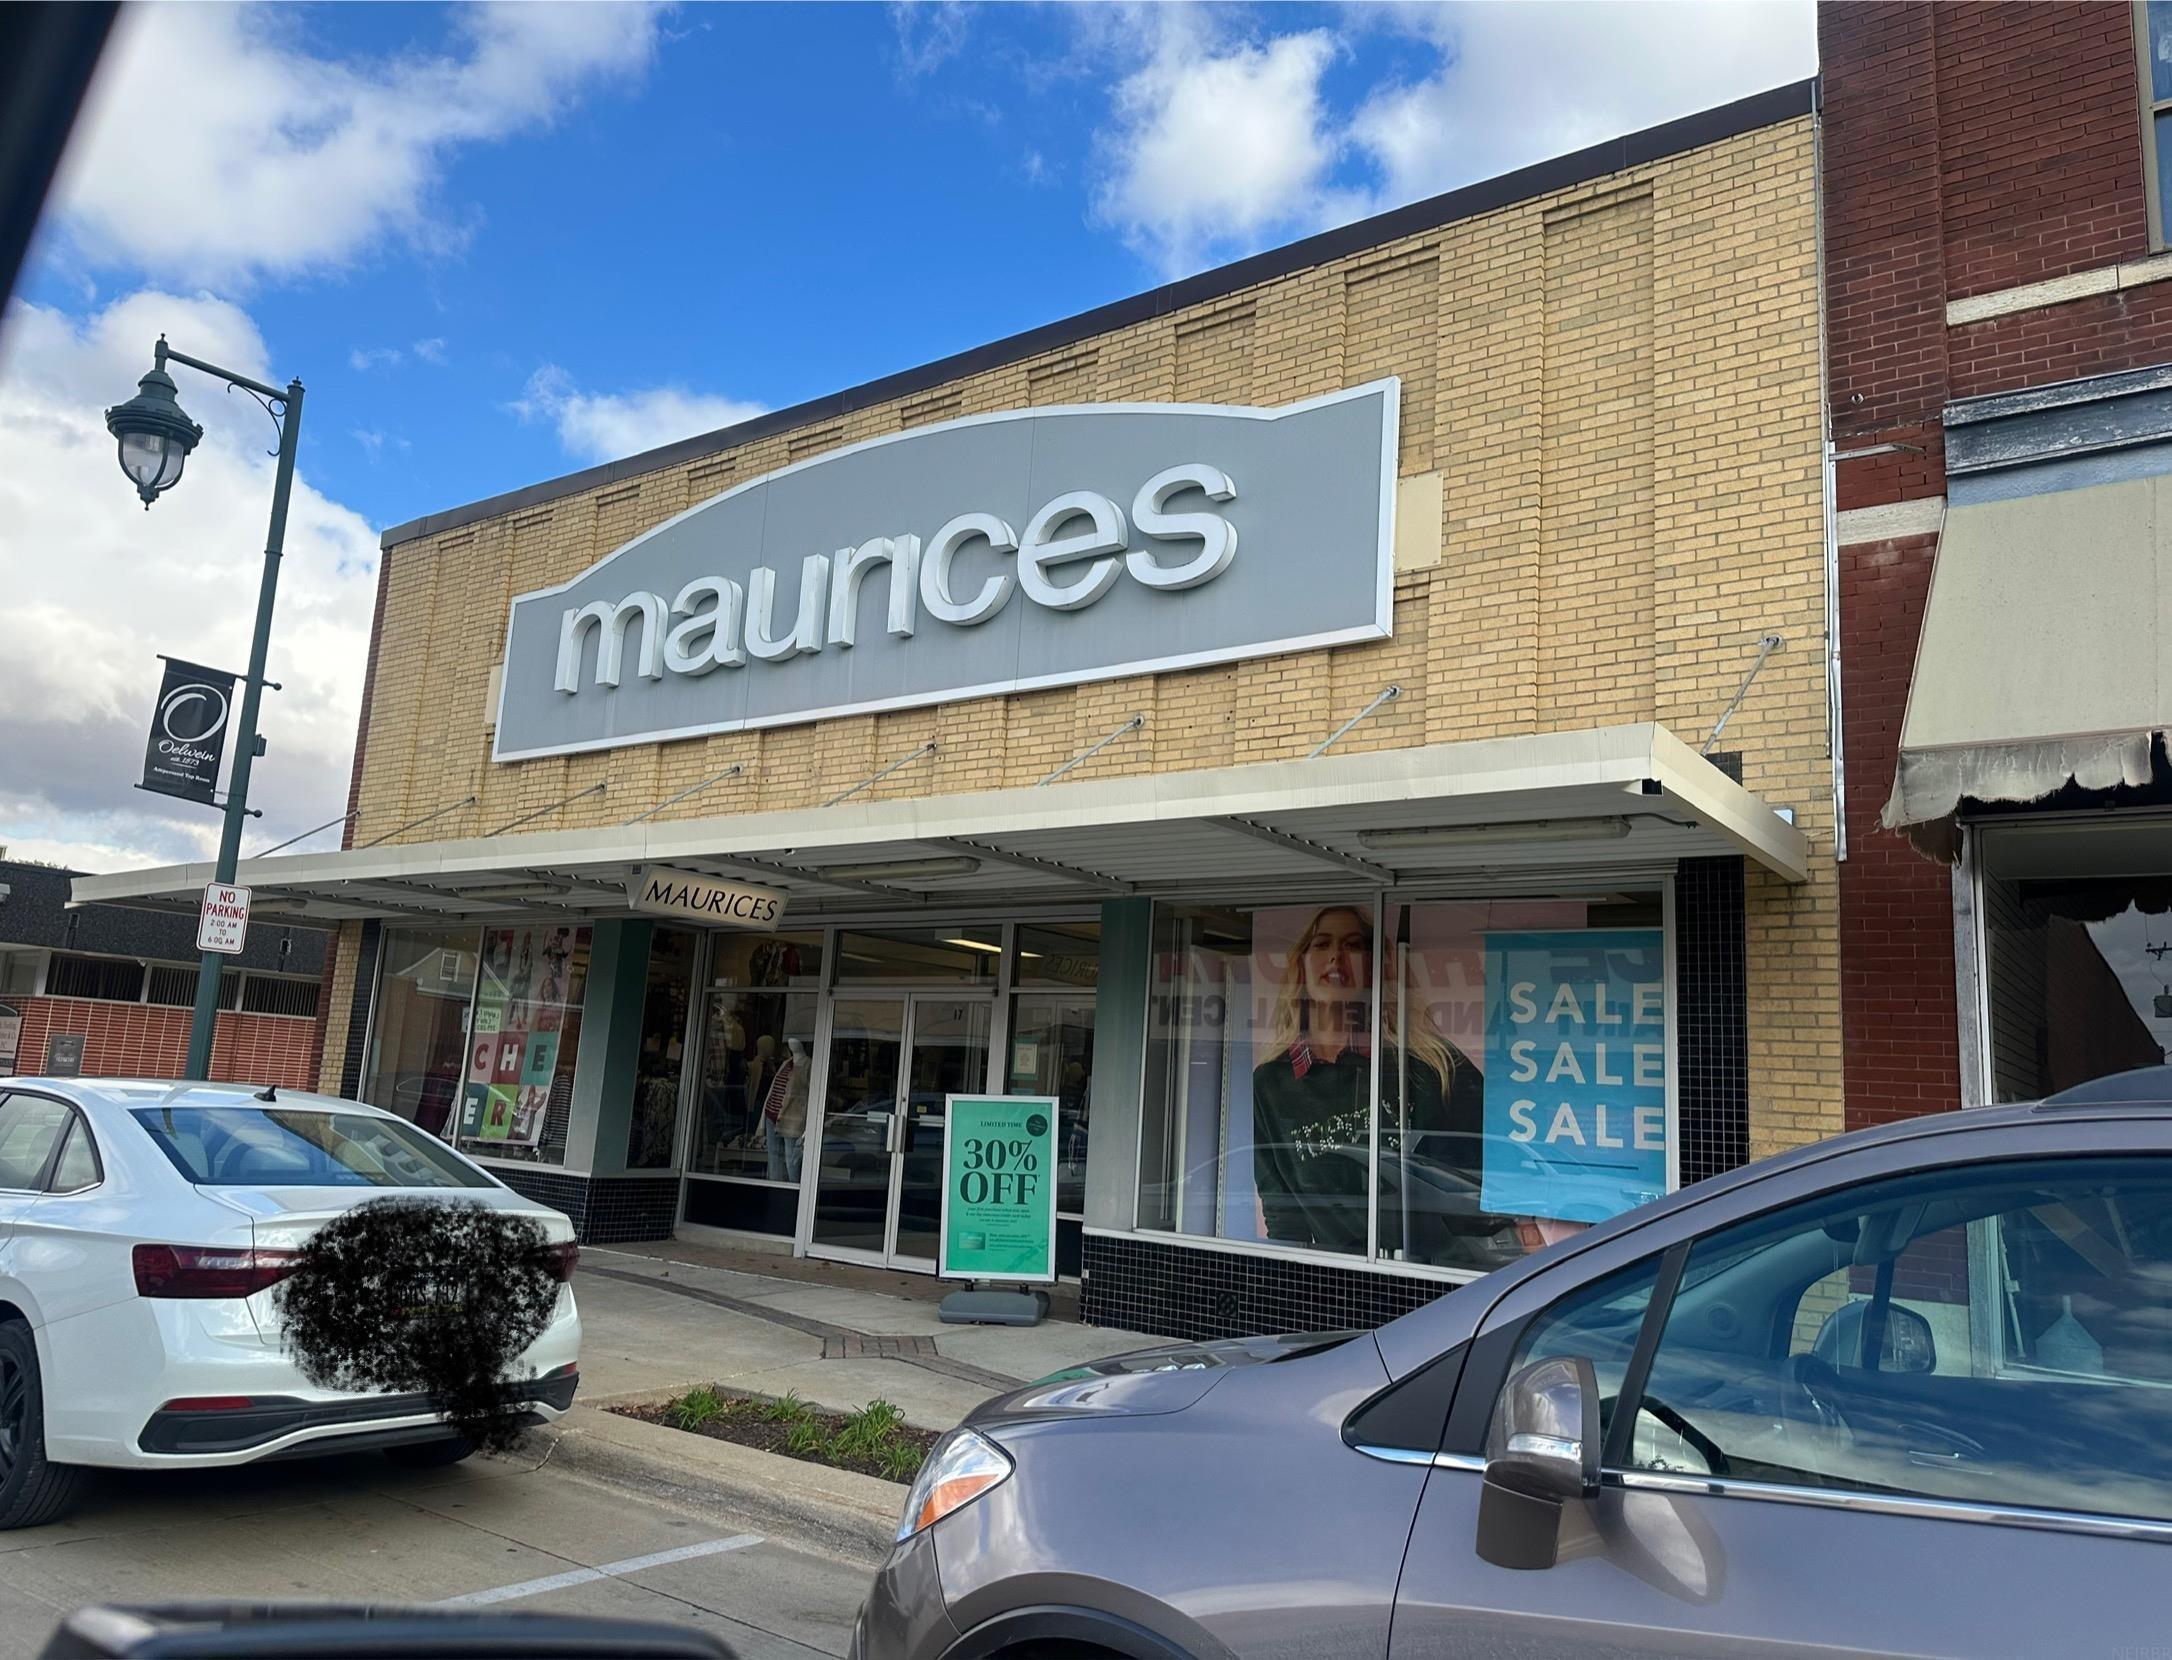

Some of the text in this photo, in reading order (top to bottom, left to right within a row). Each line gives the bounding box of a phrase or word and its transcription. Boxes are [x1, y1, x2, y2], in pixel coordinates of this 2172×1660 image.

[553, 463, 1237, 695] maurices
[158, 739, 215, 762] Oelwein
[182, 757, 200, 766] 1873
[206, 902, 245, 920] PARKING
[219, 890, 236, 904] NO
[644, 879, 778, 922] MAURICES
[954, 1009, 963, 1020] 17
[1509, 982, 1664, 1025] SALE
[1509, 1040, 1665, 1087] SALE
[1508, 1099, 1665, 1150] SALE
[963, 1138, 1038, 1172] 30%
